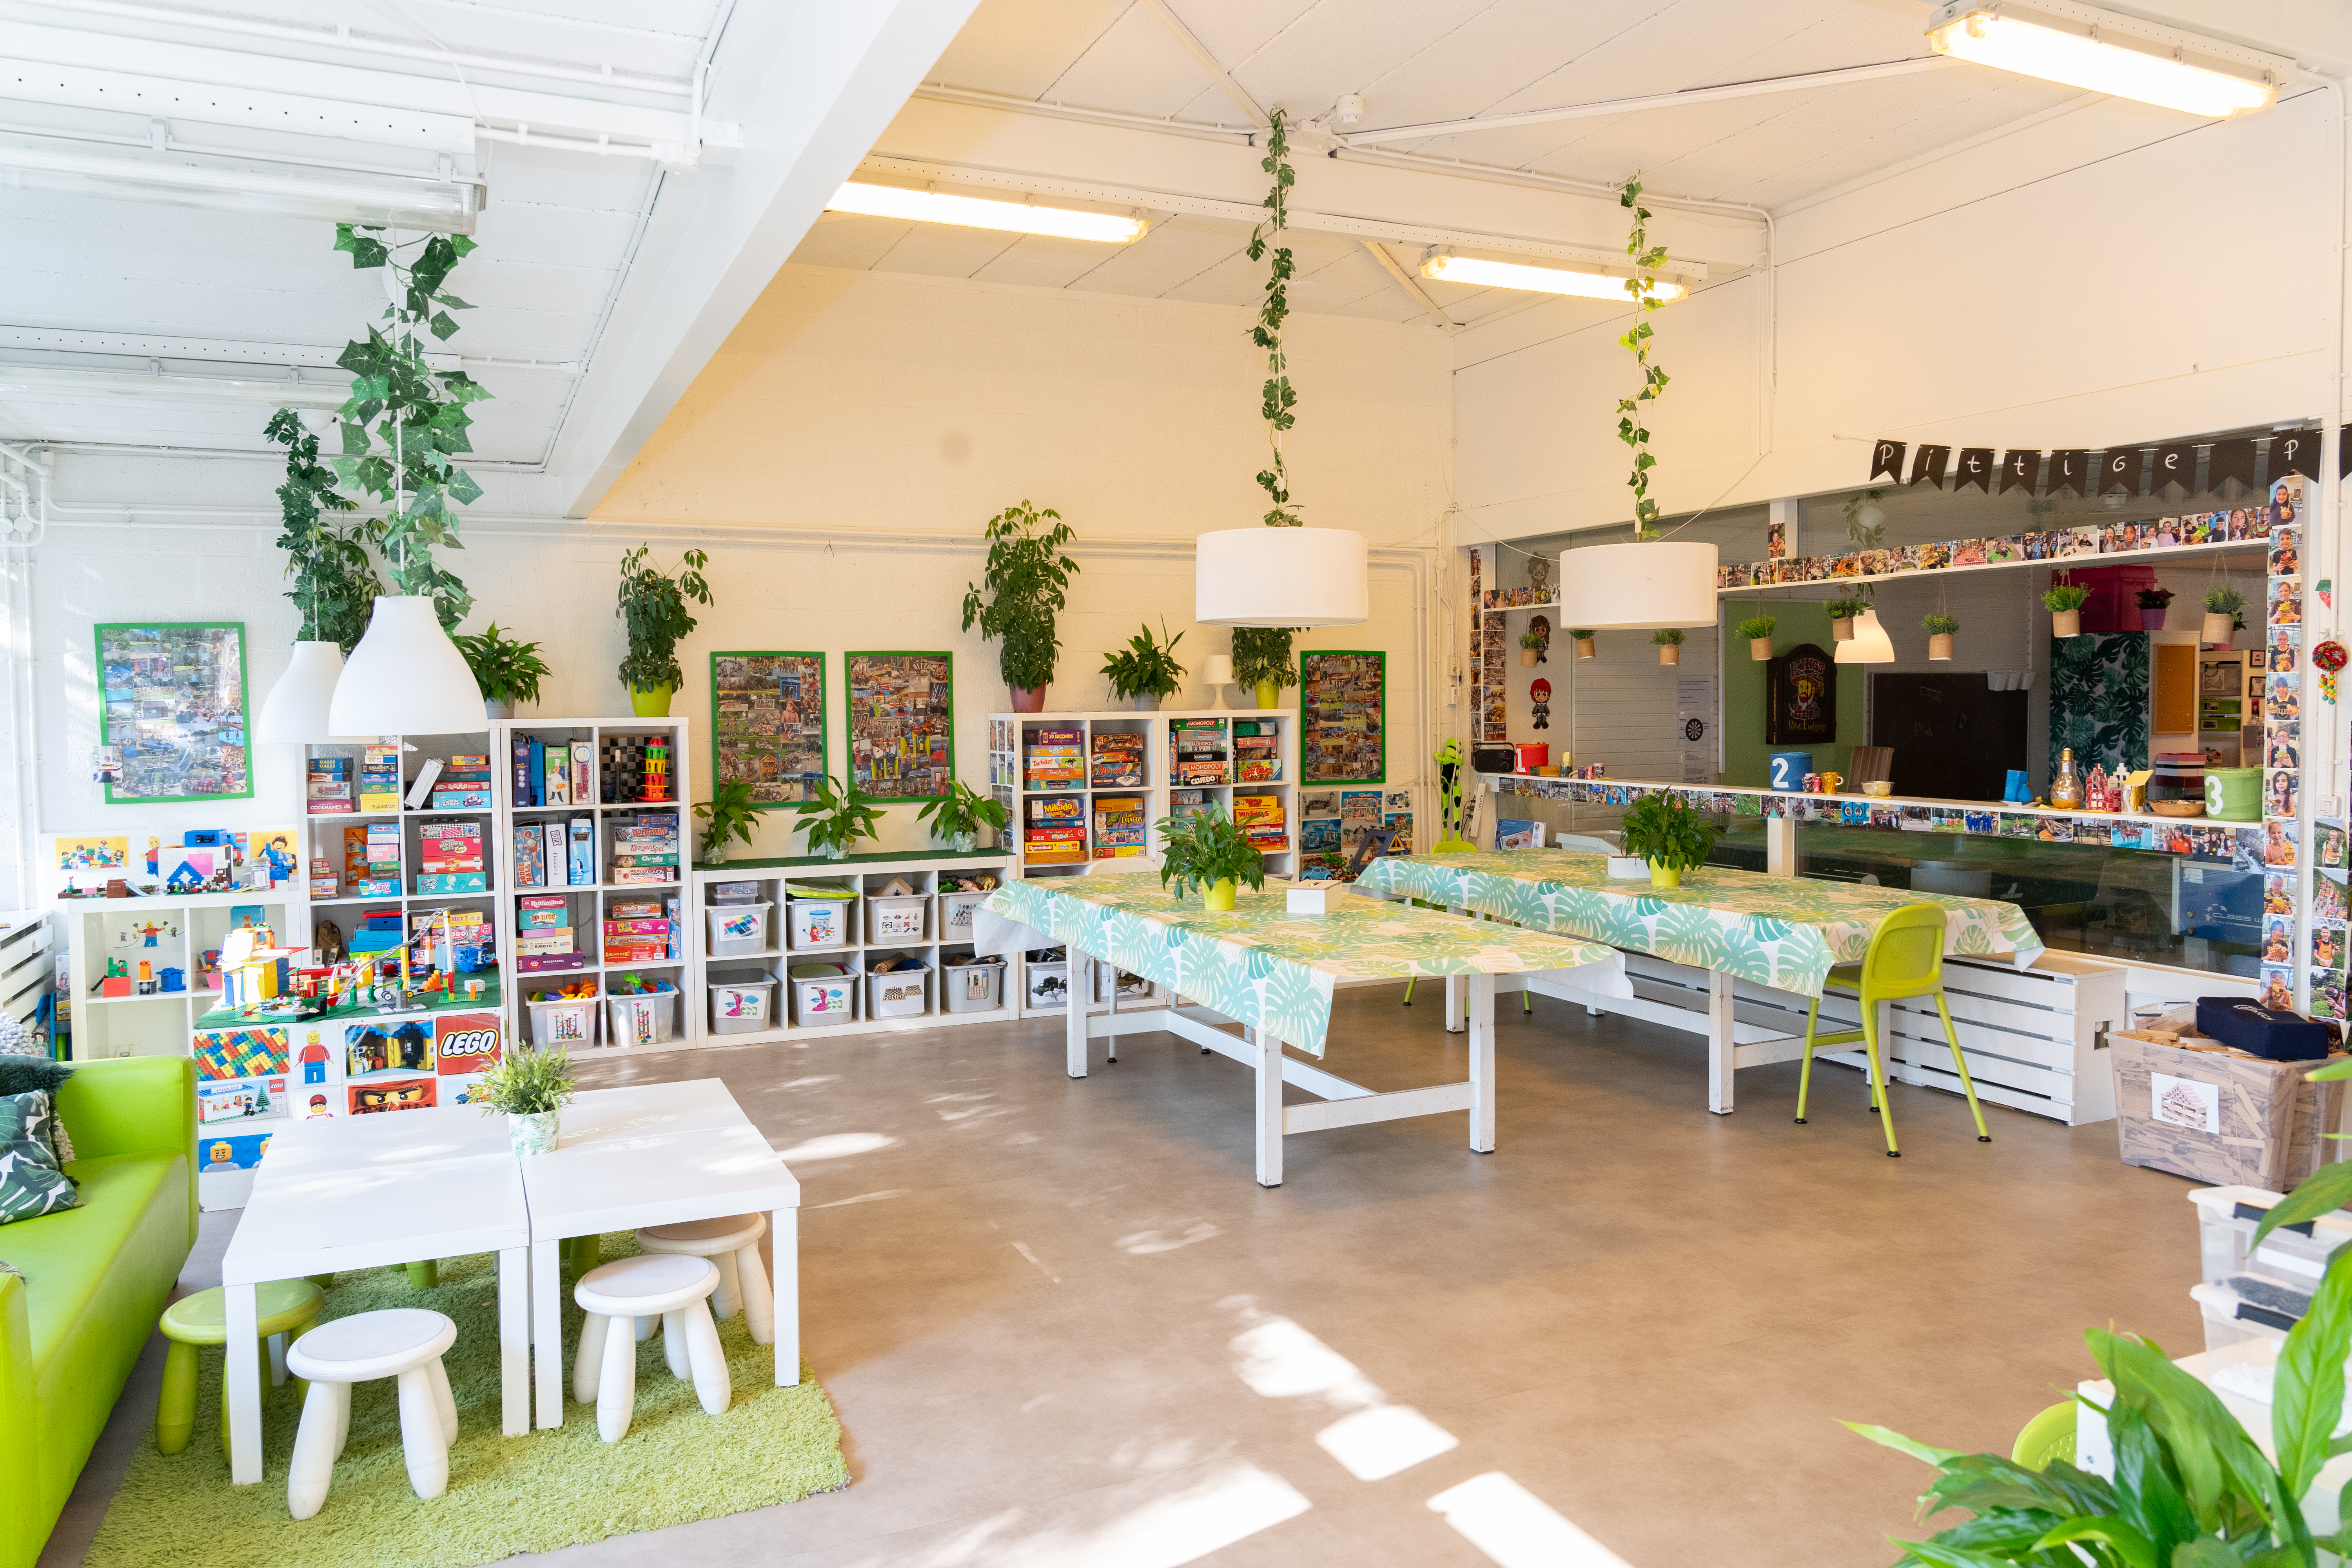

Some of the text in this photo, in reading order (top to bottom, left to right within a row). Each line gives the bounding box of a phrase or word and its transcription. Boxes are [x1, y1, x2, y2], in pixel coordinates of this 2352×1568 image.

[1790, 658, 1825, 681] KINGS
[1793, 704, 1820, 720] HEAD
[1804, 719, 1826, 732] Lodging
[1032, 758, 1053, 767] Twister
[1516, 748, 1526, 773] 1
[1191, 775, 1215, 785] CLUEDO
[1772, 757, 1789, 788] 2
[2205, 775, 2223, 815] 3
[1044, 803, 1073, 813] Mikado
[550, 831, 559, 846] ROCK
[519, 863, 527, 885] DODGE
[531, 899, 564, 907] Rummikub
[442, 1031, 495, 1055] LEGO
